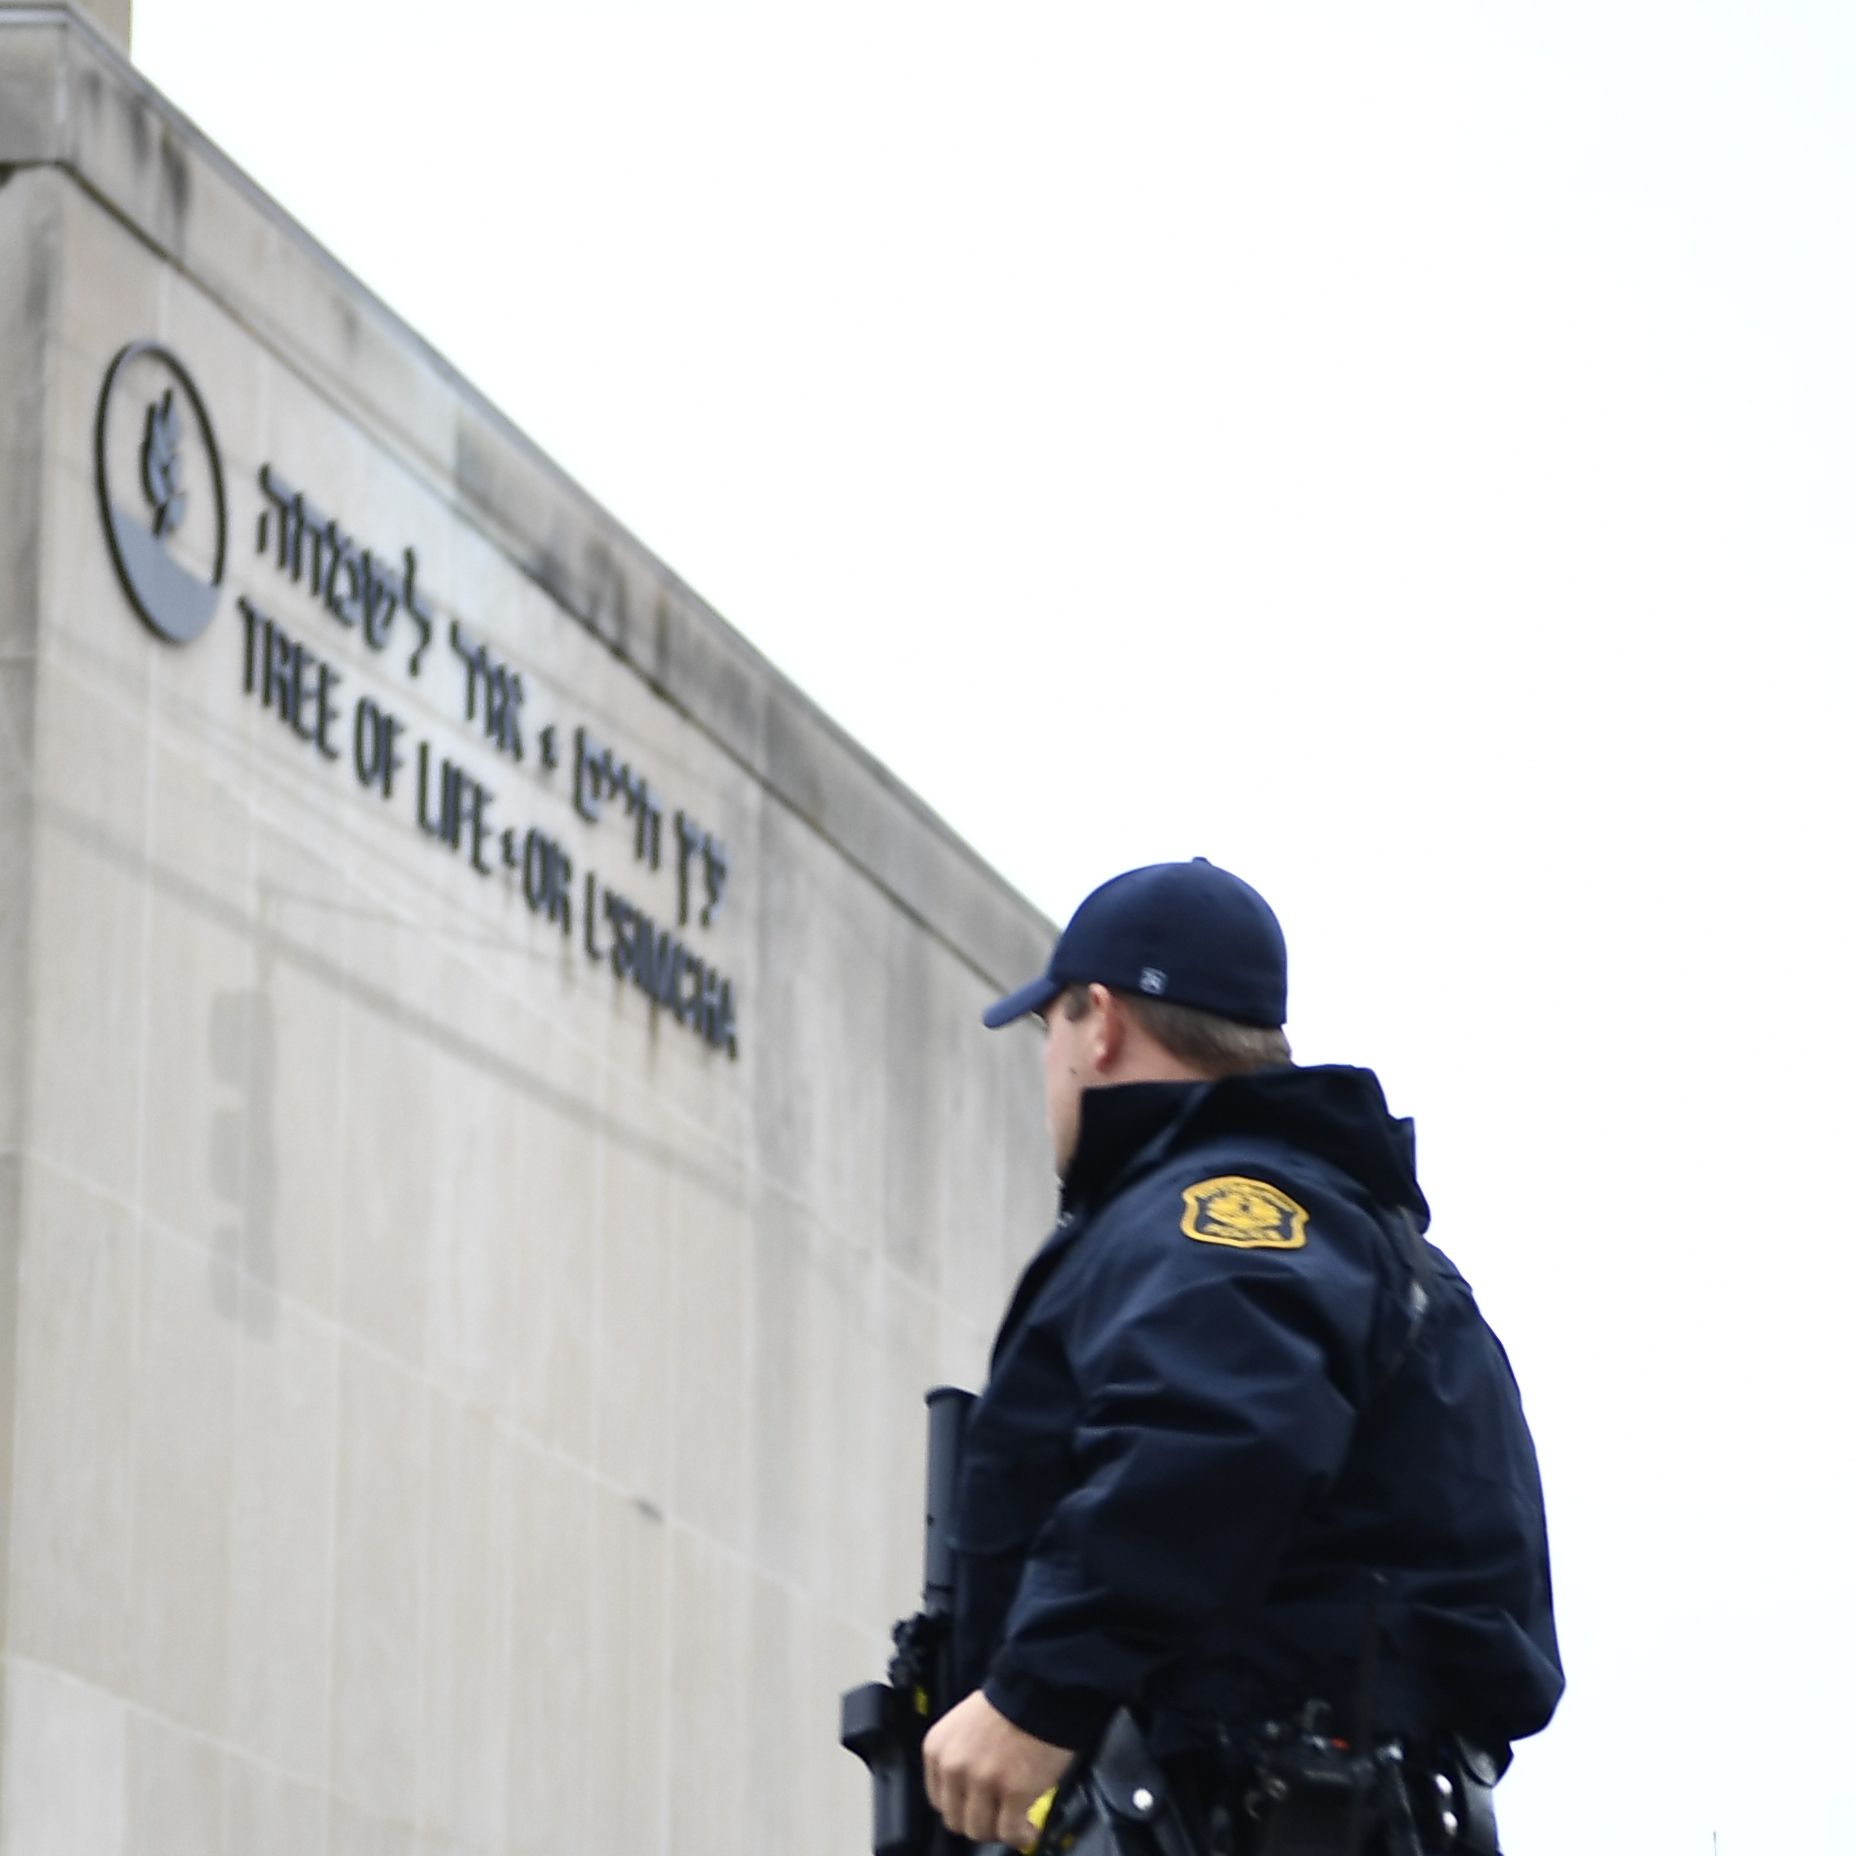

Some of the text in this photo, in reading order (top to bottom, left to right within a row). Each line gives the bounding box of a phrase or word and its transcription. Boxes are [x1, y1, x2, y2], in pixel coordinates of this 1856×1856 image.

[236, 595, 342, 761] TREE
[353, 695, 407, 801] OF
[417, 738, 496, 877] LIFE
[523, 826, 572, 938] OR
